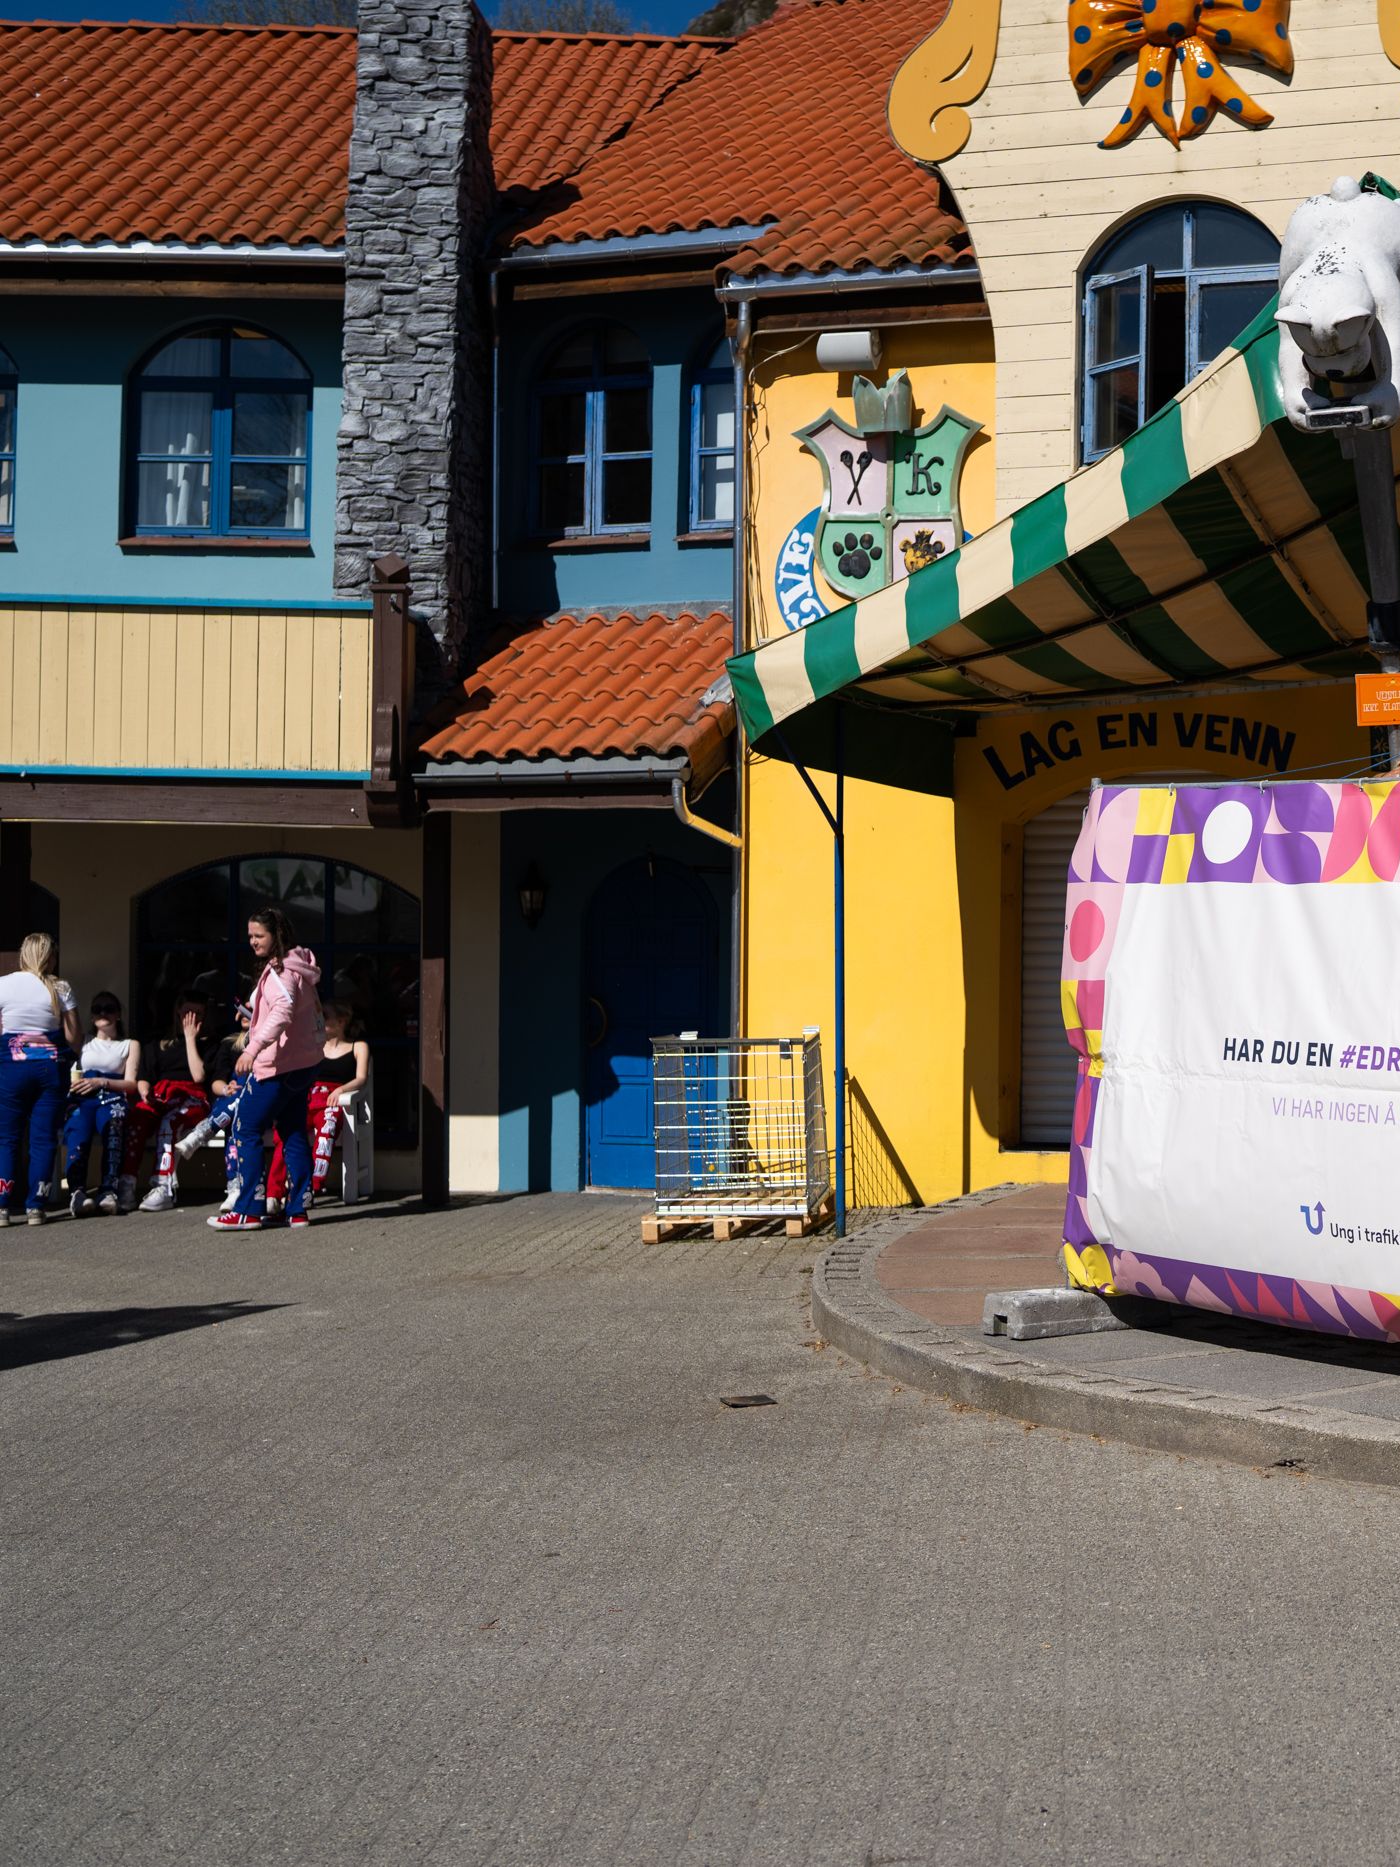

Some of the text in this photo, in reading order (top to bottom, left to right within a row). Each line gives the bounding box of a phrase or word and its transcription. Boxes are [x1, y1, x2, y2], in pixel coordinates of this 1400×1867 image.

[904, 451, 945, 496] K
[1363, 703, 1379, 712] IKKE
[982, 712, 1296, 791] LAG EN VENN
[1222, 1037, 1265, 1063] HAR
[1271, 1040, 1300, 1065] DU
[1305, 1042, 1334, 1067] EN
[1272, 1097, 1286, 1116] VI
[1291, 1099, 1324, 1120] HAR
[1328, 1102, 1379, 1124] INGEN
[1384, 1105, 1397, 1126] Å
[1330, 1222, 1355, 1244] Ung
[1357, 1225, 1362, 1241] i
